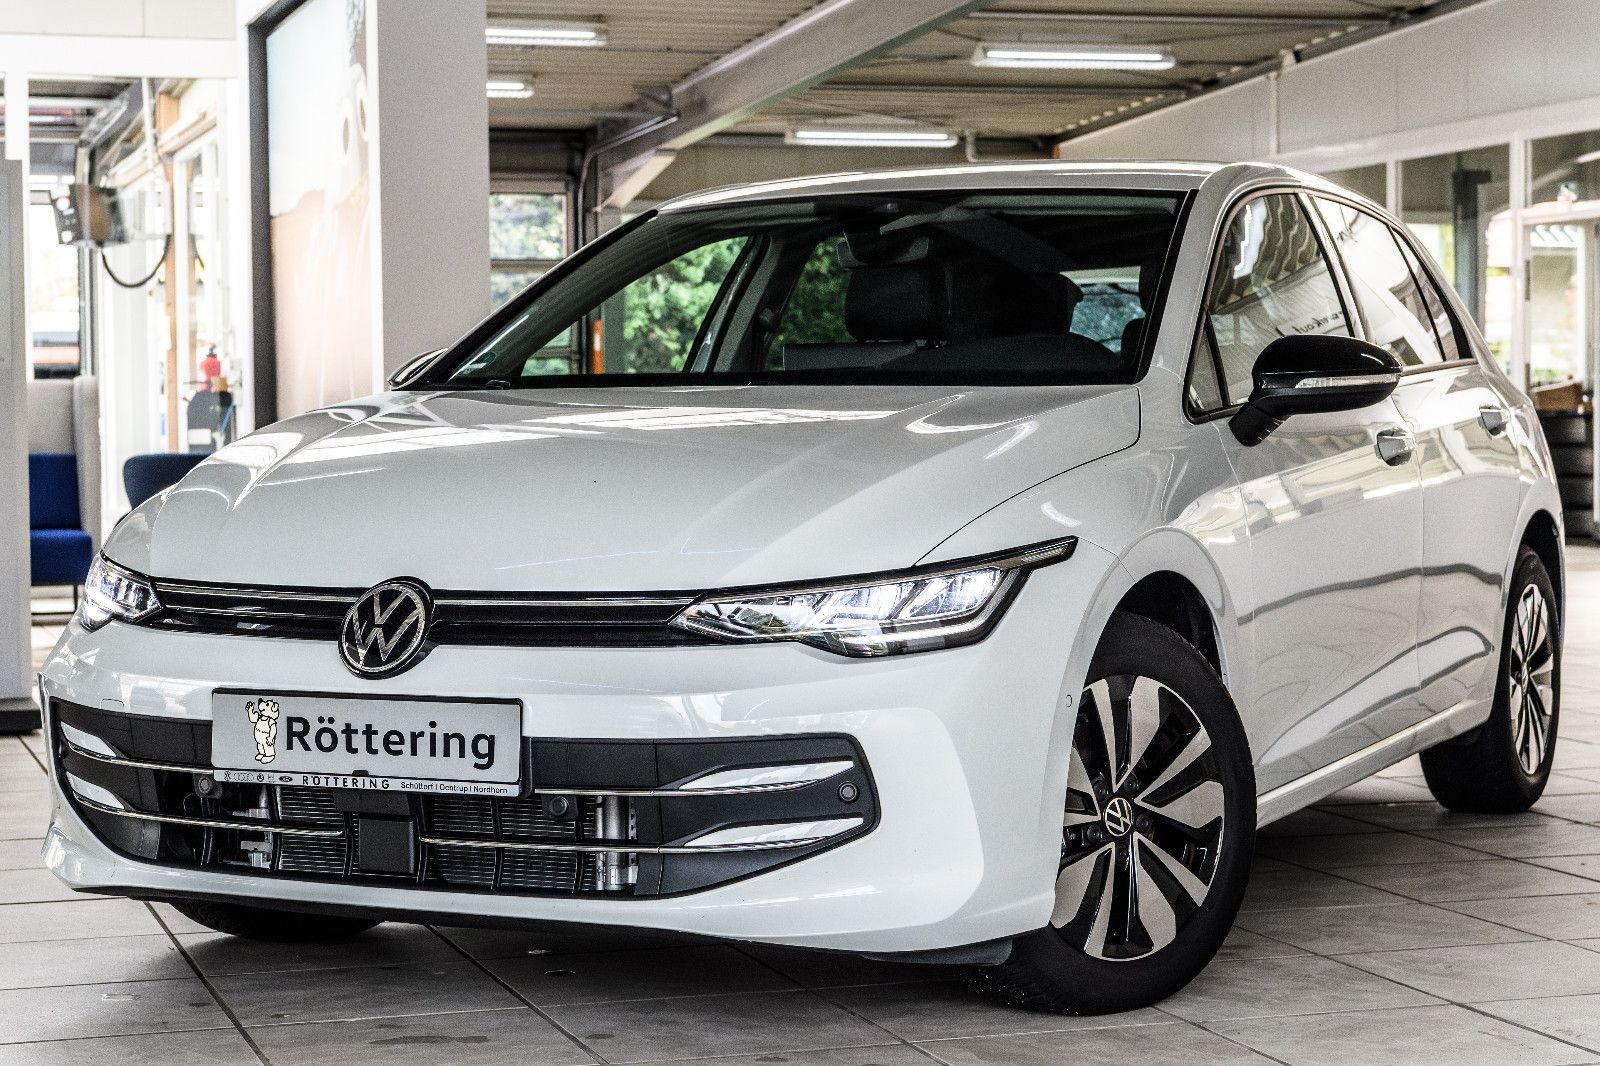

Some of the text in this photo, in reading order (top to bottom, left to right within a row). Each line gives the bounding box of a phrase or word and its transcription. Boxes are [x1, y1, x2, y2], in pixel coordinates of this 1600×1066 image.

[346, 585, 424, 670] VW
[286, 715, 496, 770] Röttering
[302, 775, 390, 789] RÖTTERING
